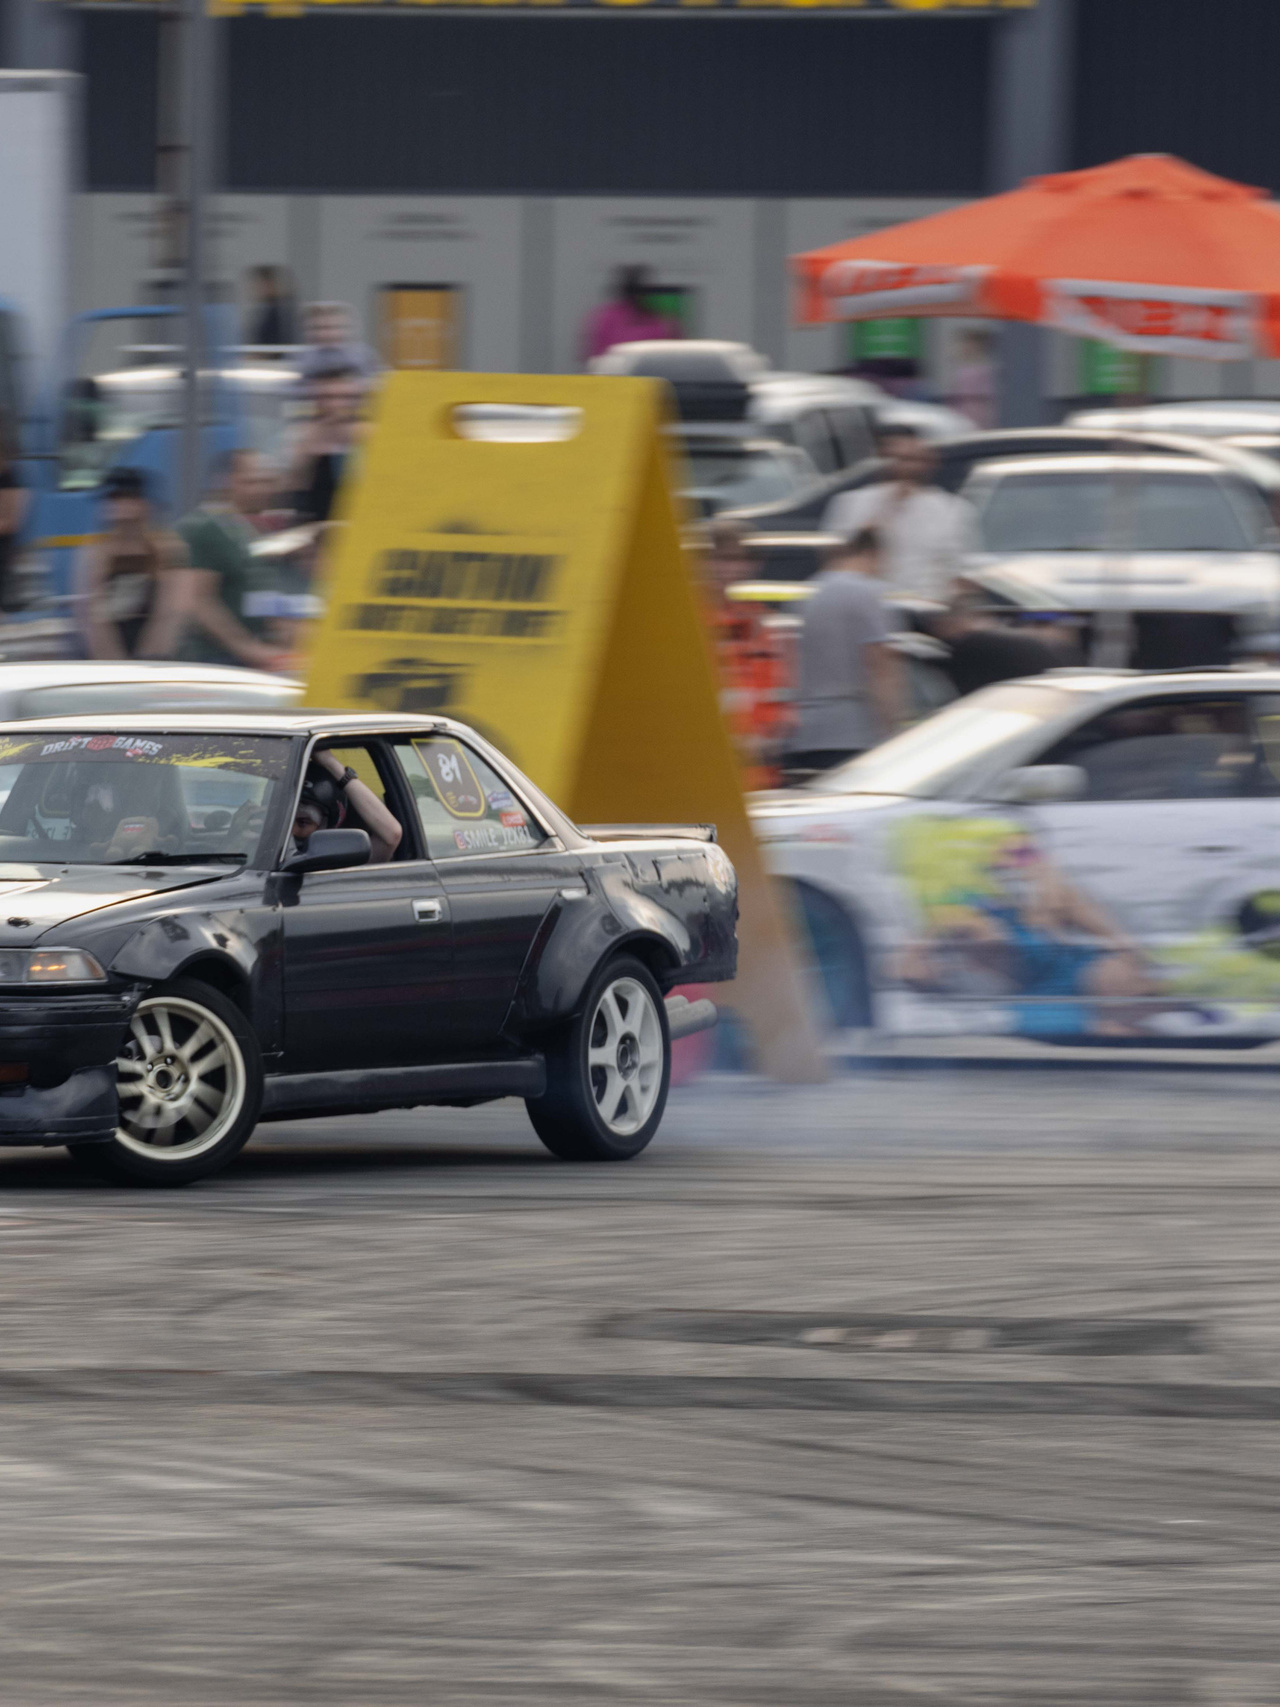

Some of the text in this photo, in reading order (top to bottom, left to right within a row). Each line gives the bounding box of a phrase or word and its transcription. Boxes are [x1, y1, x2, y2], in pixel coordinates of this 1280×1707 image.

[40, 737, 163, 756] DRIFT GAMES
[437, 752, 463, 785] 81
